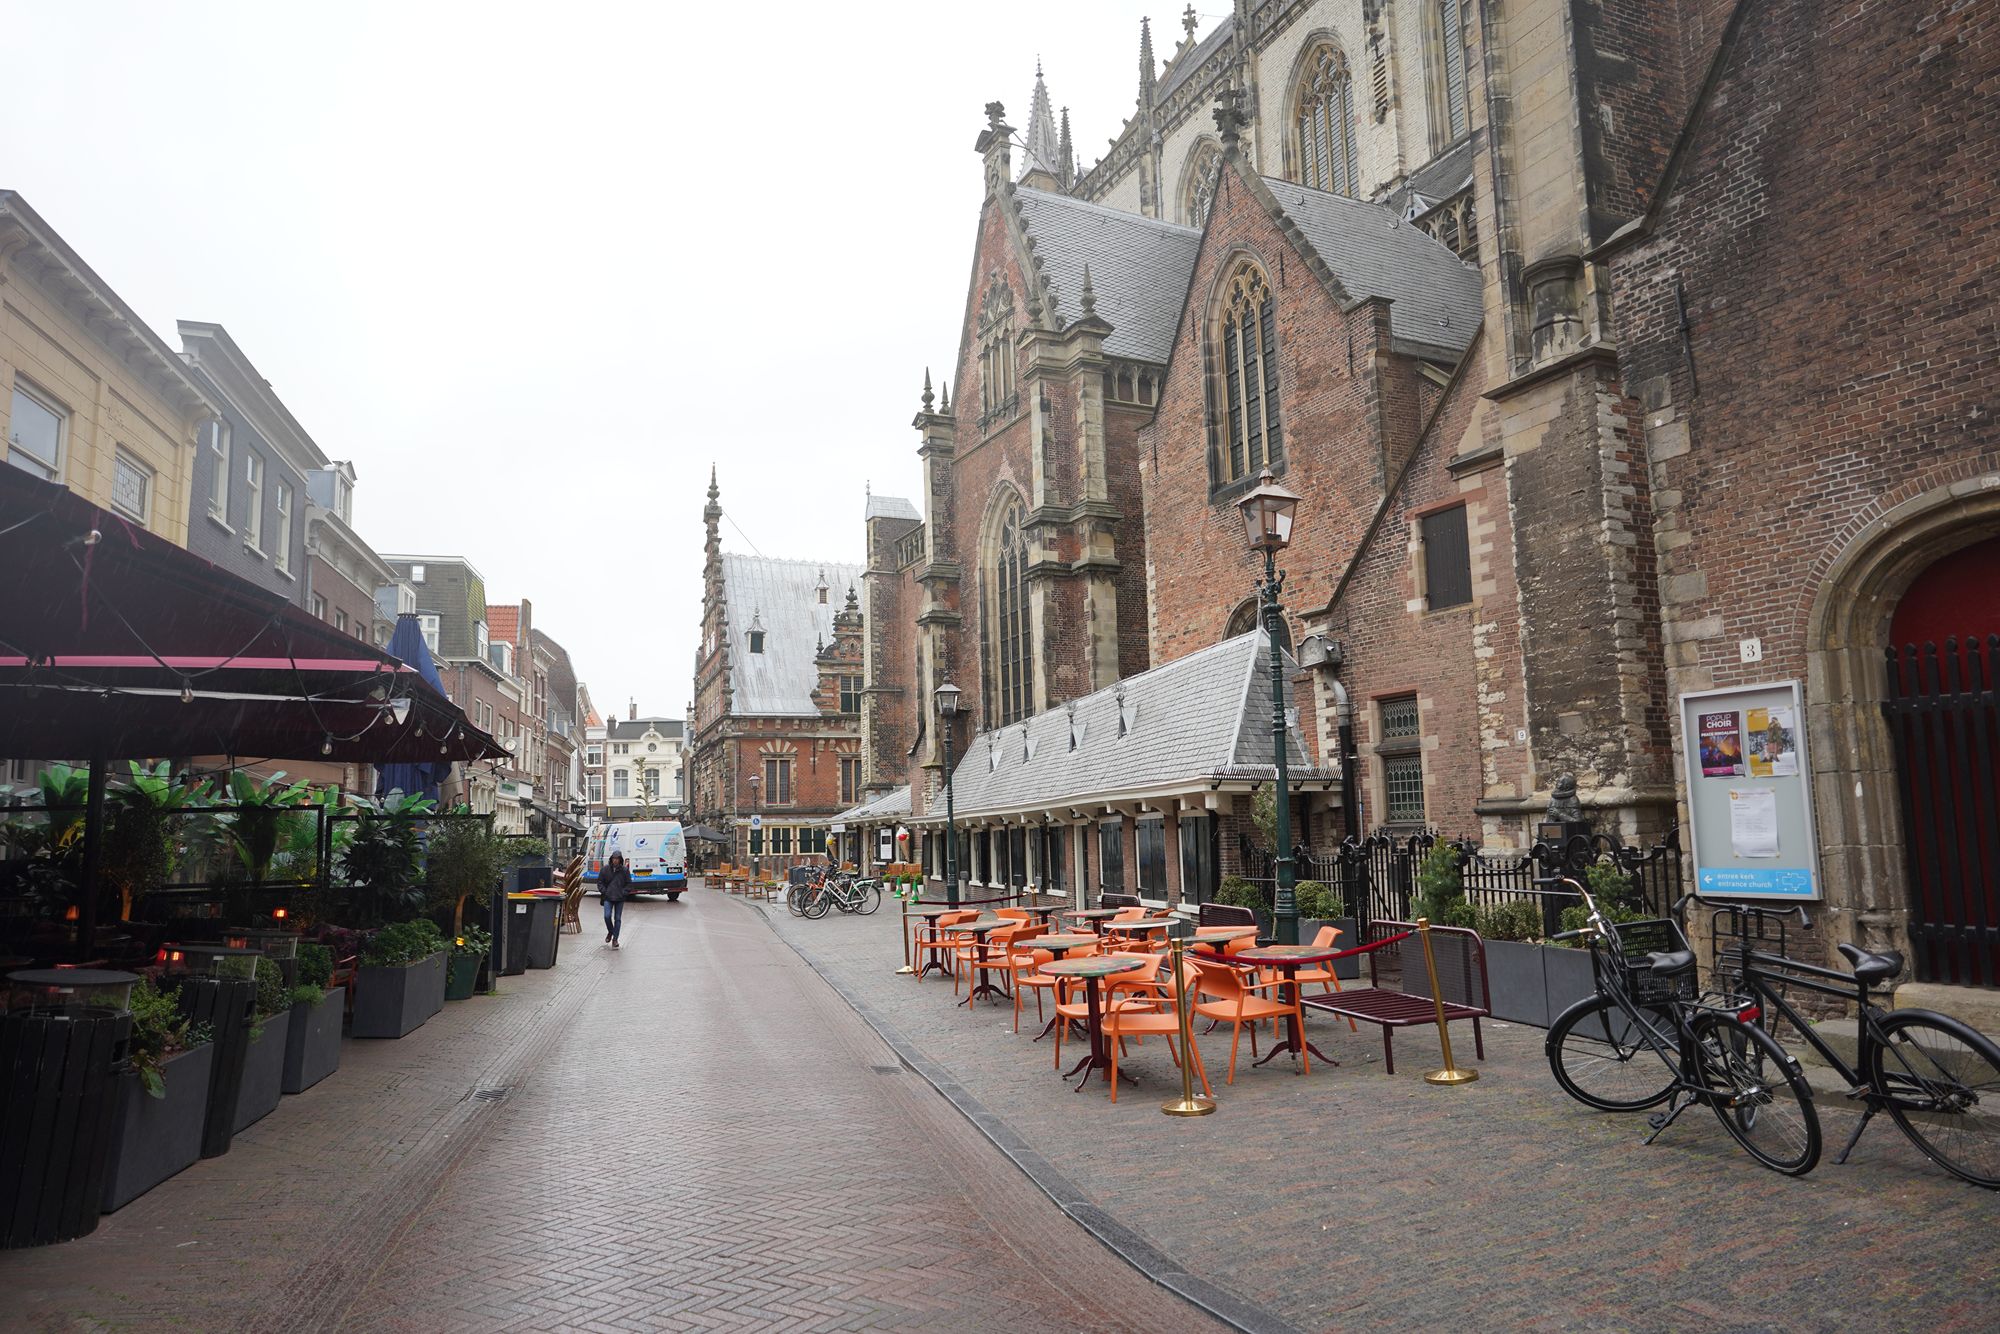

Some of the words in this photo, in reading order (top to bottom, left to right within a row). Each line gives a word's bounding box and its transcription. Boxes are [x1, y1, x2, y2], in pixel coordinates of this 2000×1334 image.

[1746, 644, 1755, 657] 3
[1706, 714, 1731, 722] POPUP
[1706, 720, 1732, 728] CHOIR
[1748, 881, 1773, 889] church
